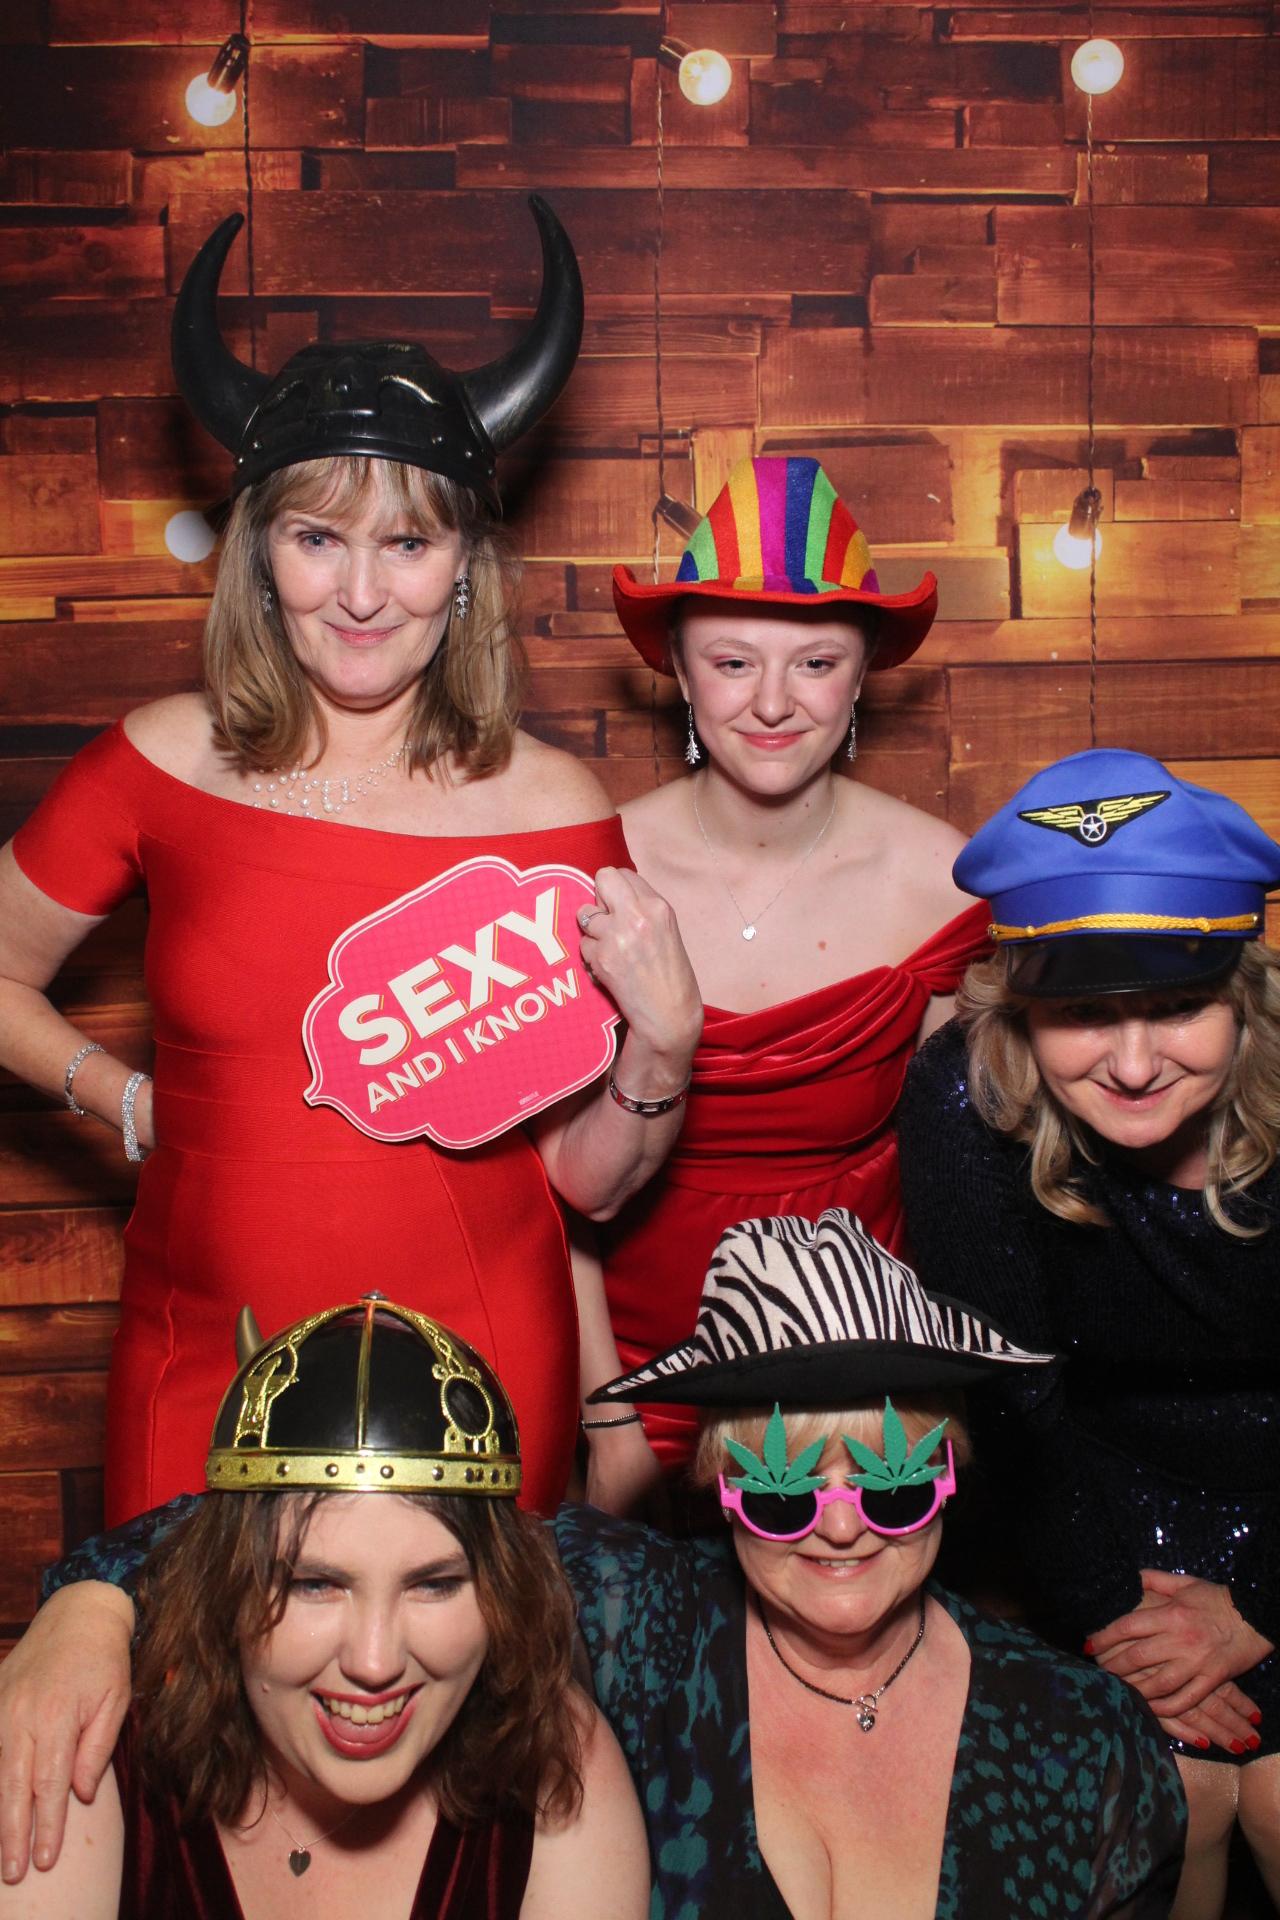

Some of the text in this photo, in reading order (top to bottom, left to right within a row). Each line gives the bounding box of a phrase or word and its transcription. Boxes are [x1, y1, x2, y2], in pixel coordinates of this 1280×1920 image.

[338, 886, 569, 1066] SEXY
[366, 967, 580, 1113] AND I KNOW
